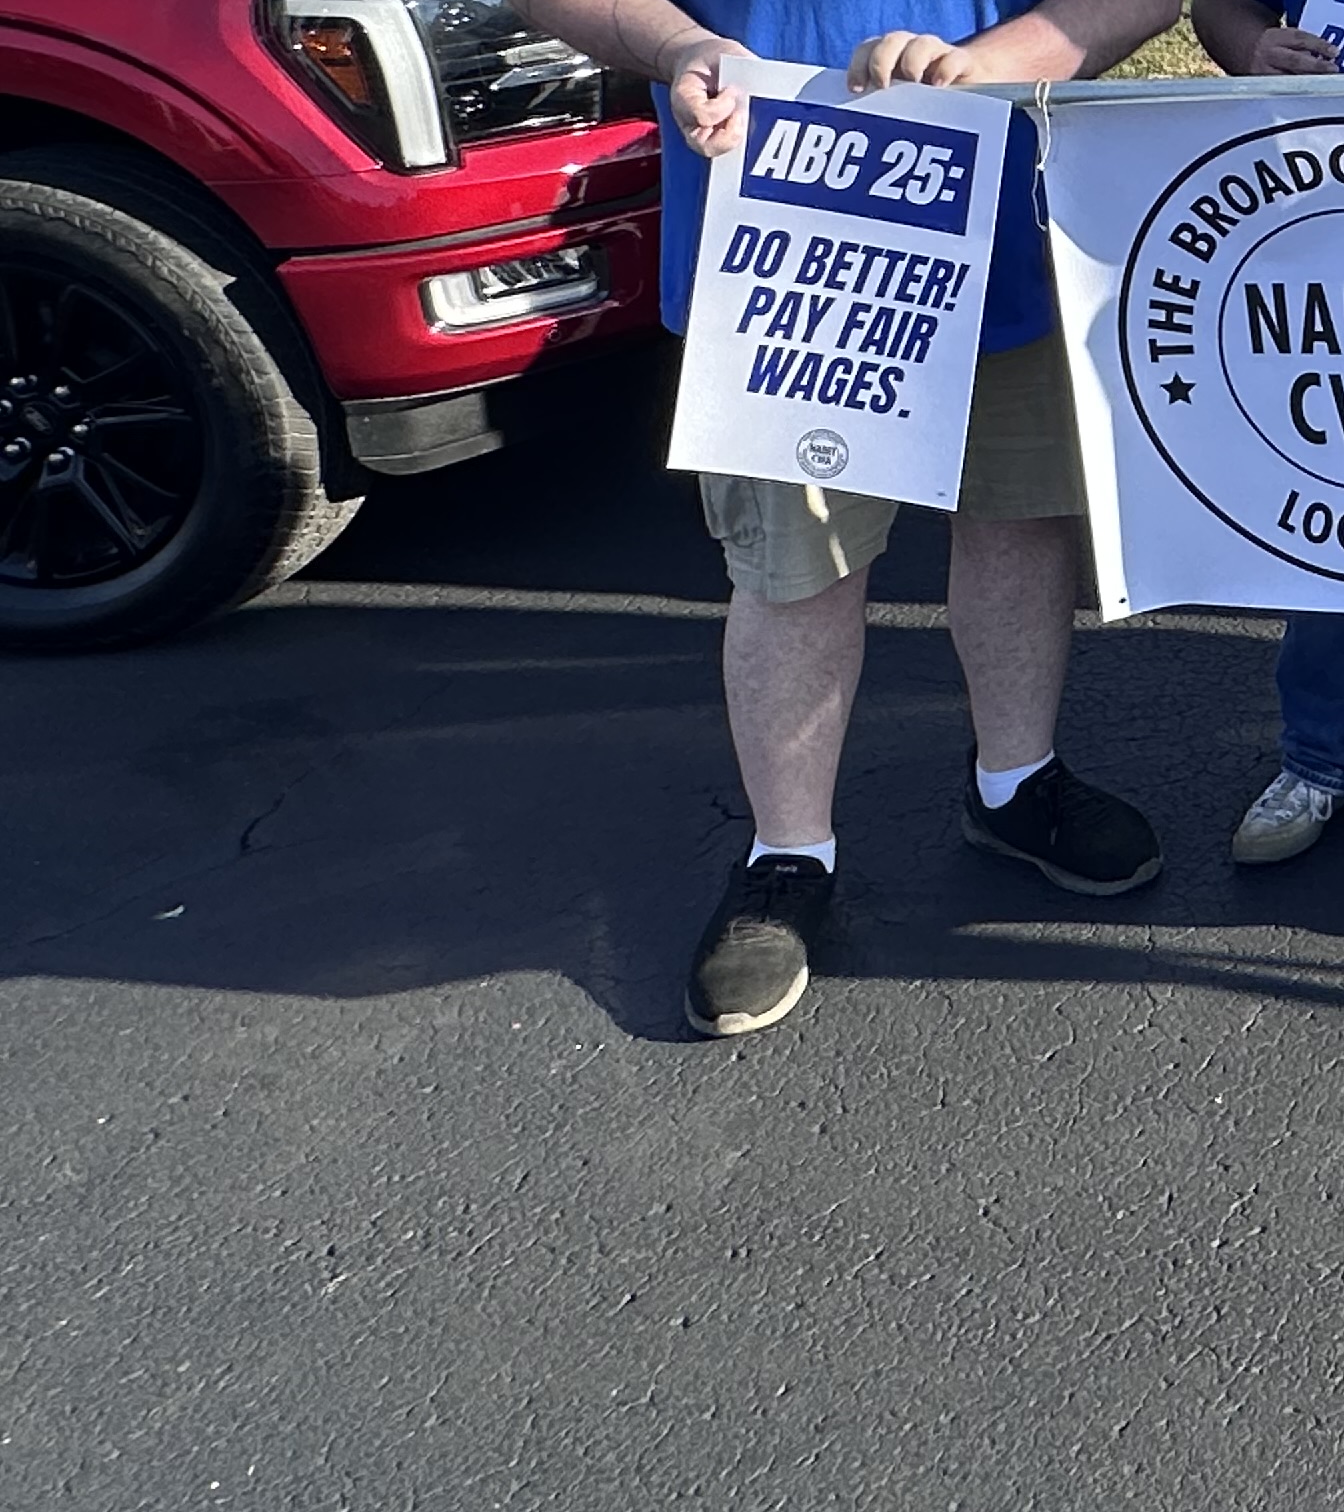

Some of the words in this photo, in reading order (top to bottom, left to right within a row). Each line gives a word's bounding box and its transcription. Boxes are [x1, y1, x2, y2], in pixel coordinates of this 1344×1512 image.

[751, 118, 869, 191] ABC
[869, 141, 966, 205] 25:
[720, 224, 791, 278] DO
[795, 235, 971, 312] BETTER!
[736, 286, 834, 344] PAY
[836, 300, 939, 364] FAIR
[1149, 268, 1201, 364] THE
[746, 344, 911, 419] WAGES.
